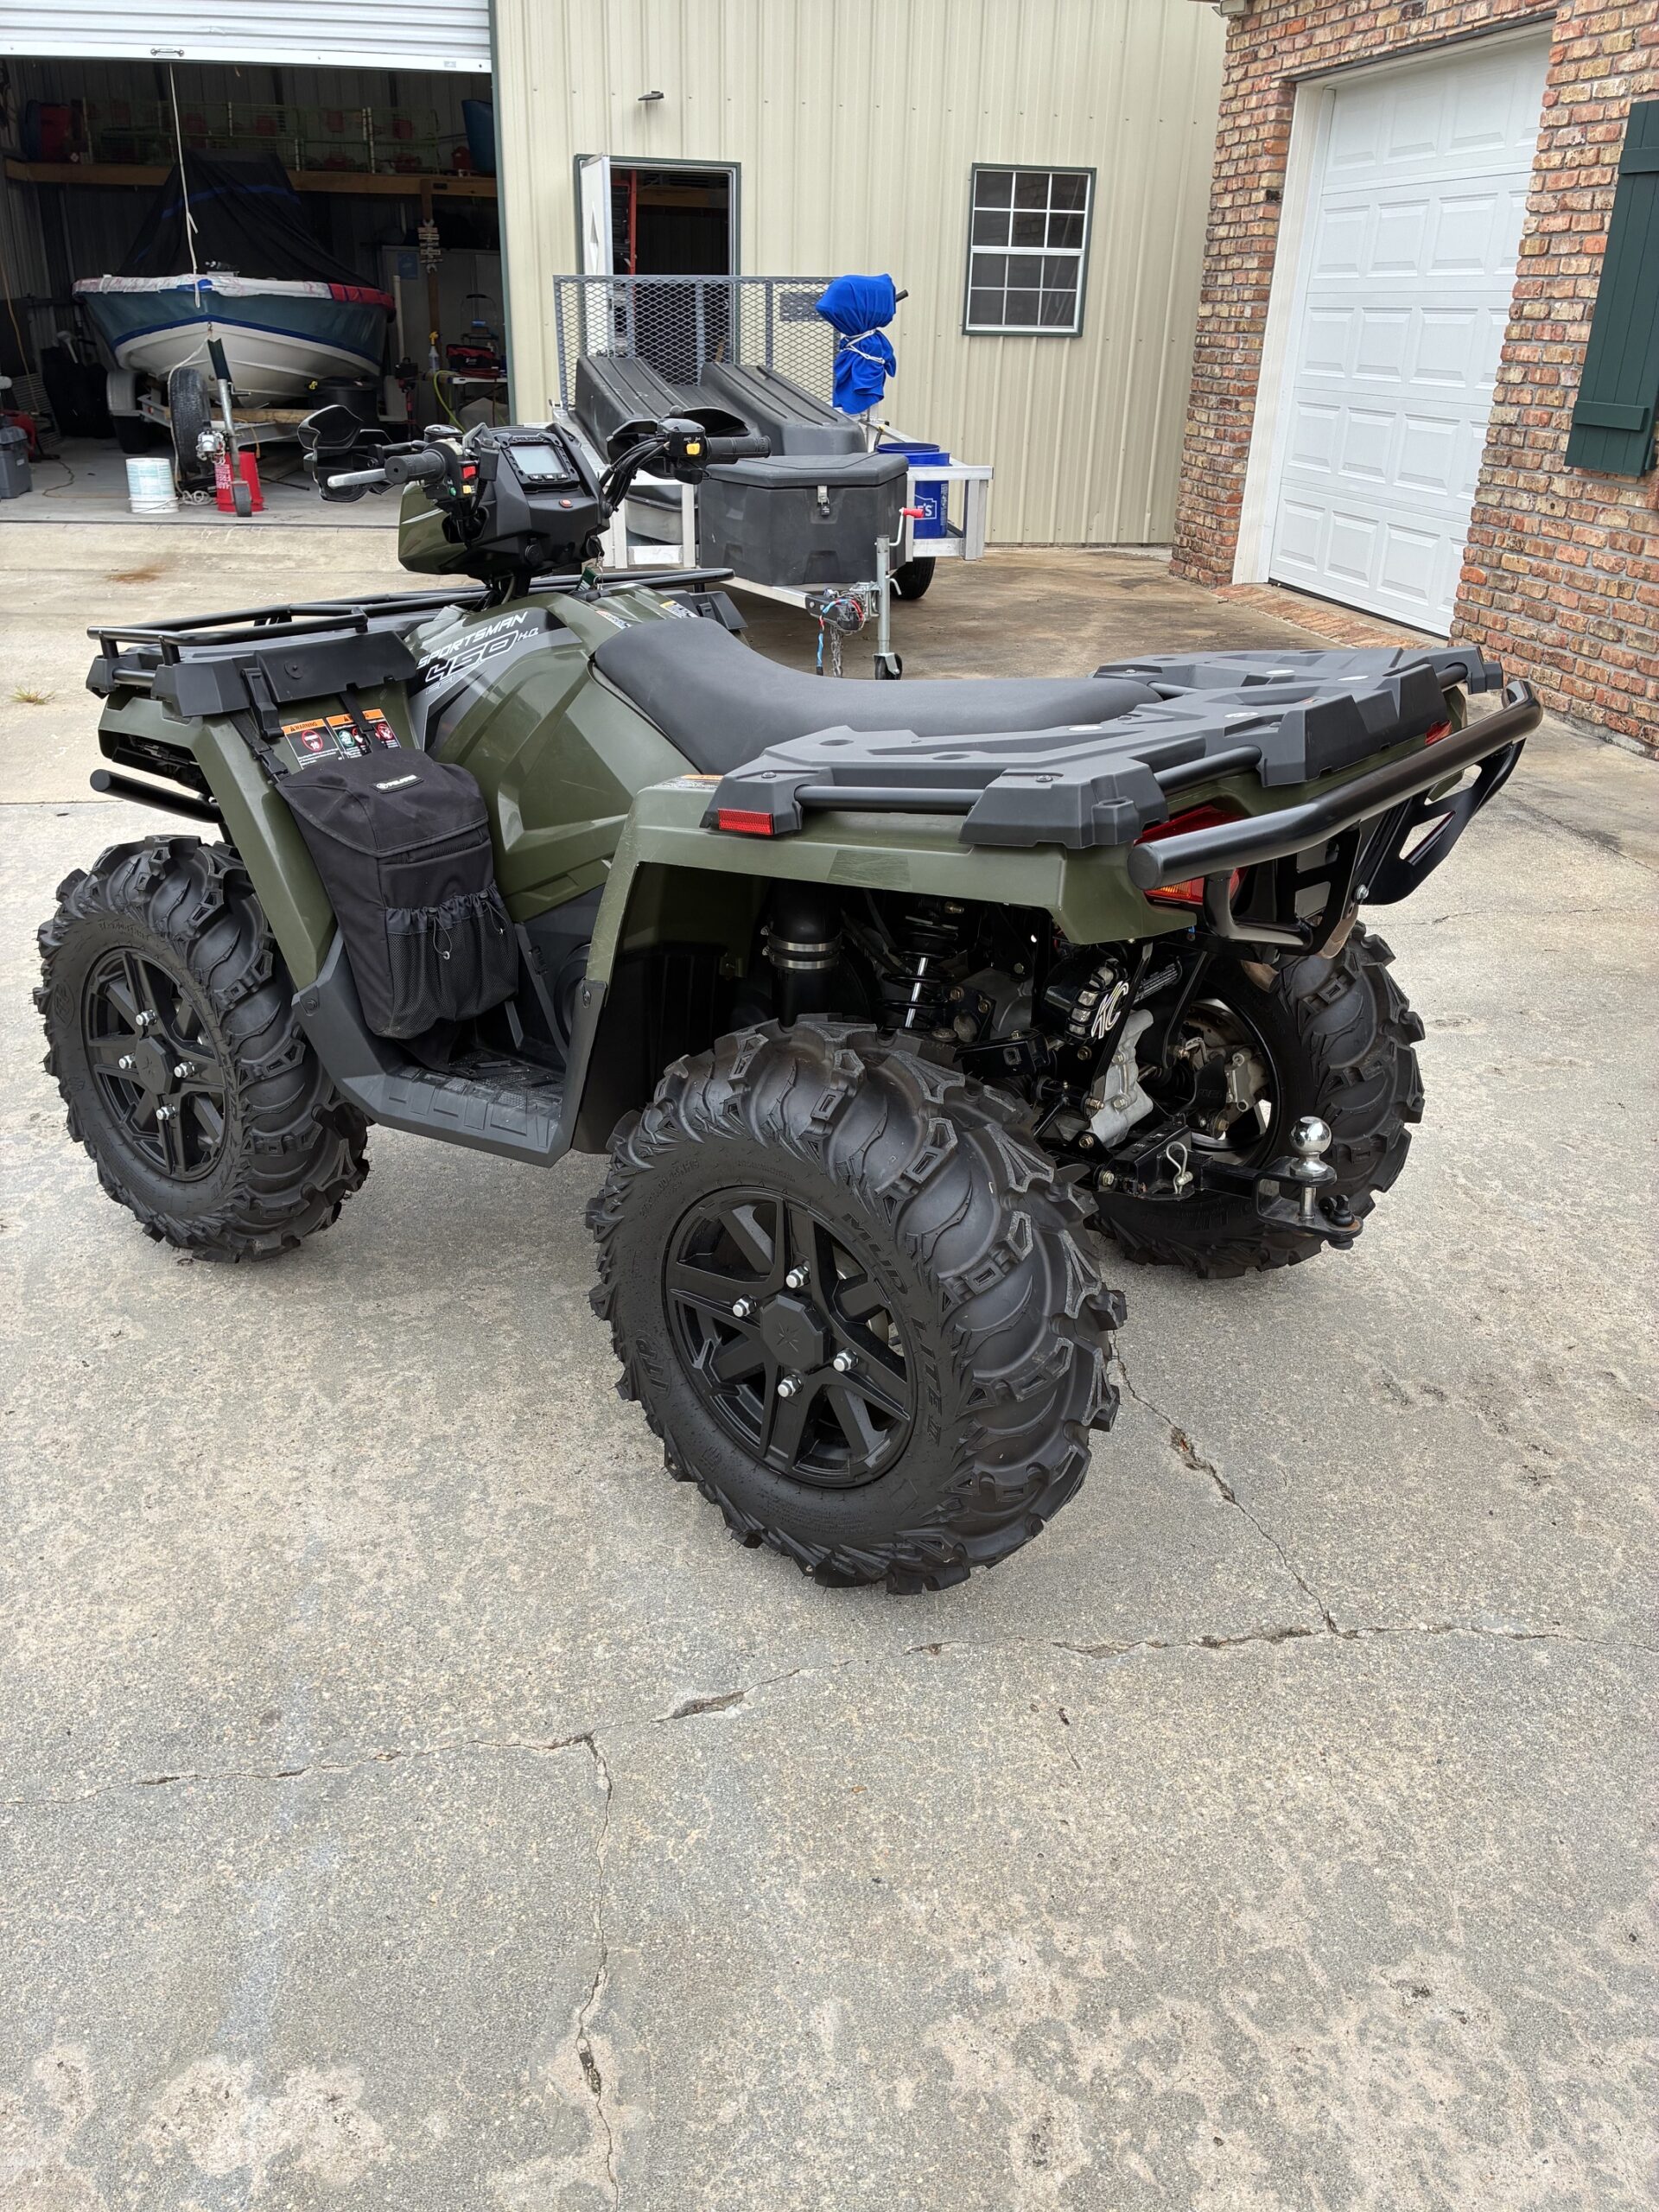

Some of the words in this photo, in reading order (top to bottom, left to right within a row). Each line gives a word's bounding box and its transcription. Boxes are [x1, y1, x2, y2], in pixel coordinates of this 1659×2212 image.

[416, 611, 528, 670] SPORTSMAN
[425, 629, 519, 683] 450
[295, 721, 318, 732] WARNING
[1090, 980, 1129, 1039] KC
[842, 1212, 907, 1295] MUD
[911, 1316, 943, 1416] LITE
[635, 1338, 671, 1392] ITP
